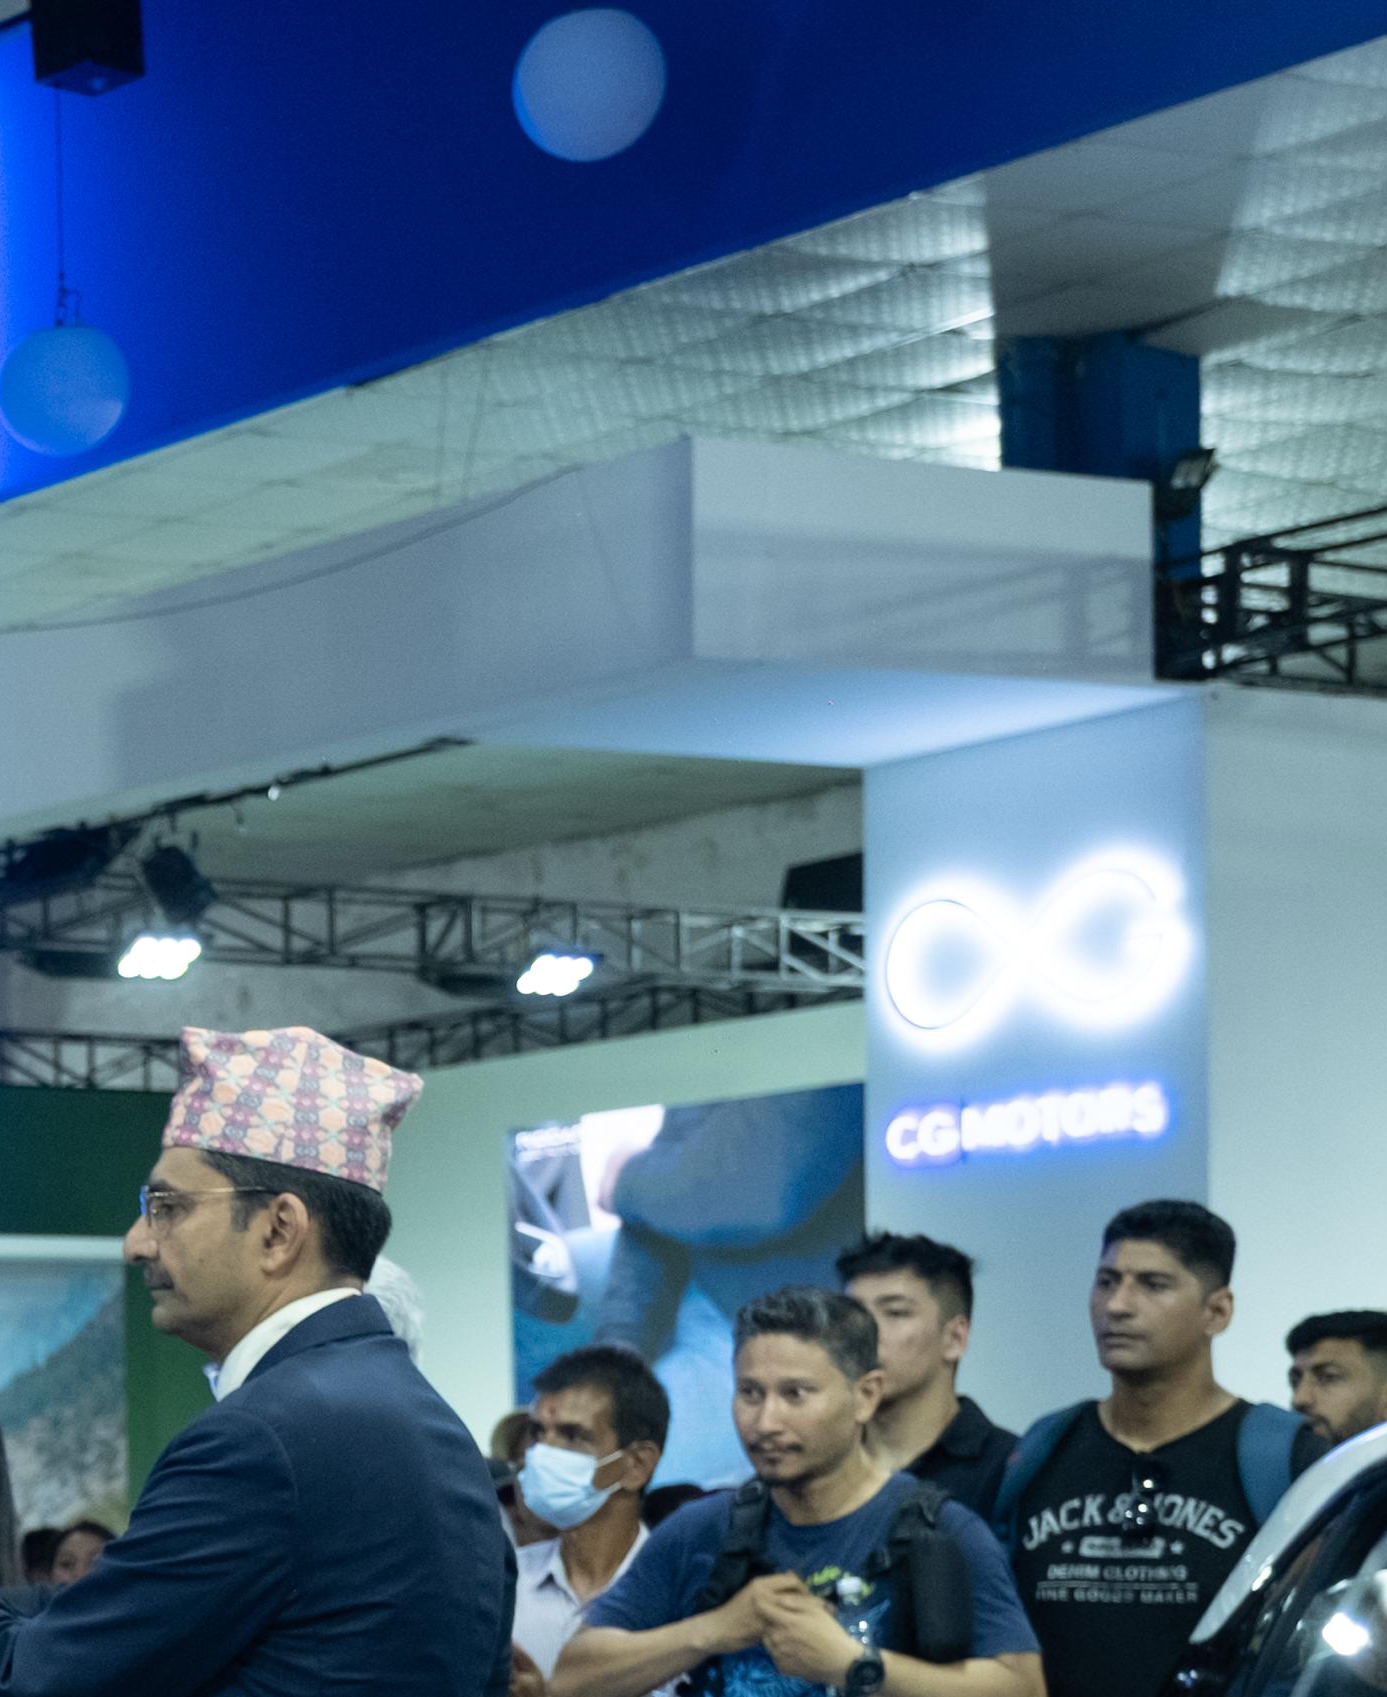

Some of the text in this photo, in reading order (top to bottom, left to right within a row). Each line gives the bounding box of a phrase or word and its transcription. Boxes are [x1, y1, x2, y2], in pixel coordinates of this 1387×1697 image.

[885, 1082, 1167, 1160] CG MOTORS
[1022, 1494, 1106, 1550] JACK
[1047, 1564, 1188, 1581] DENIM CLOTHING
